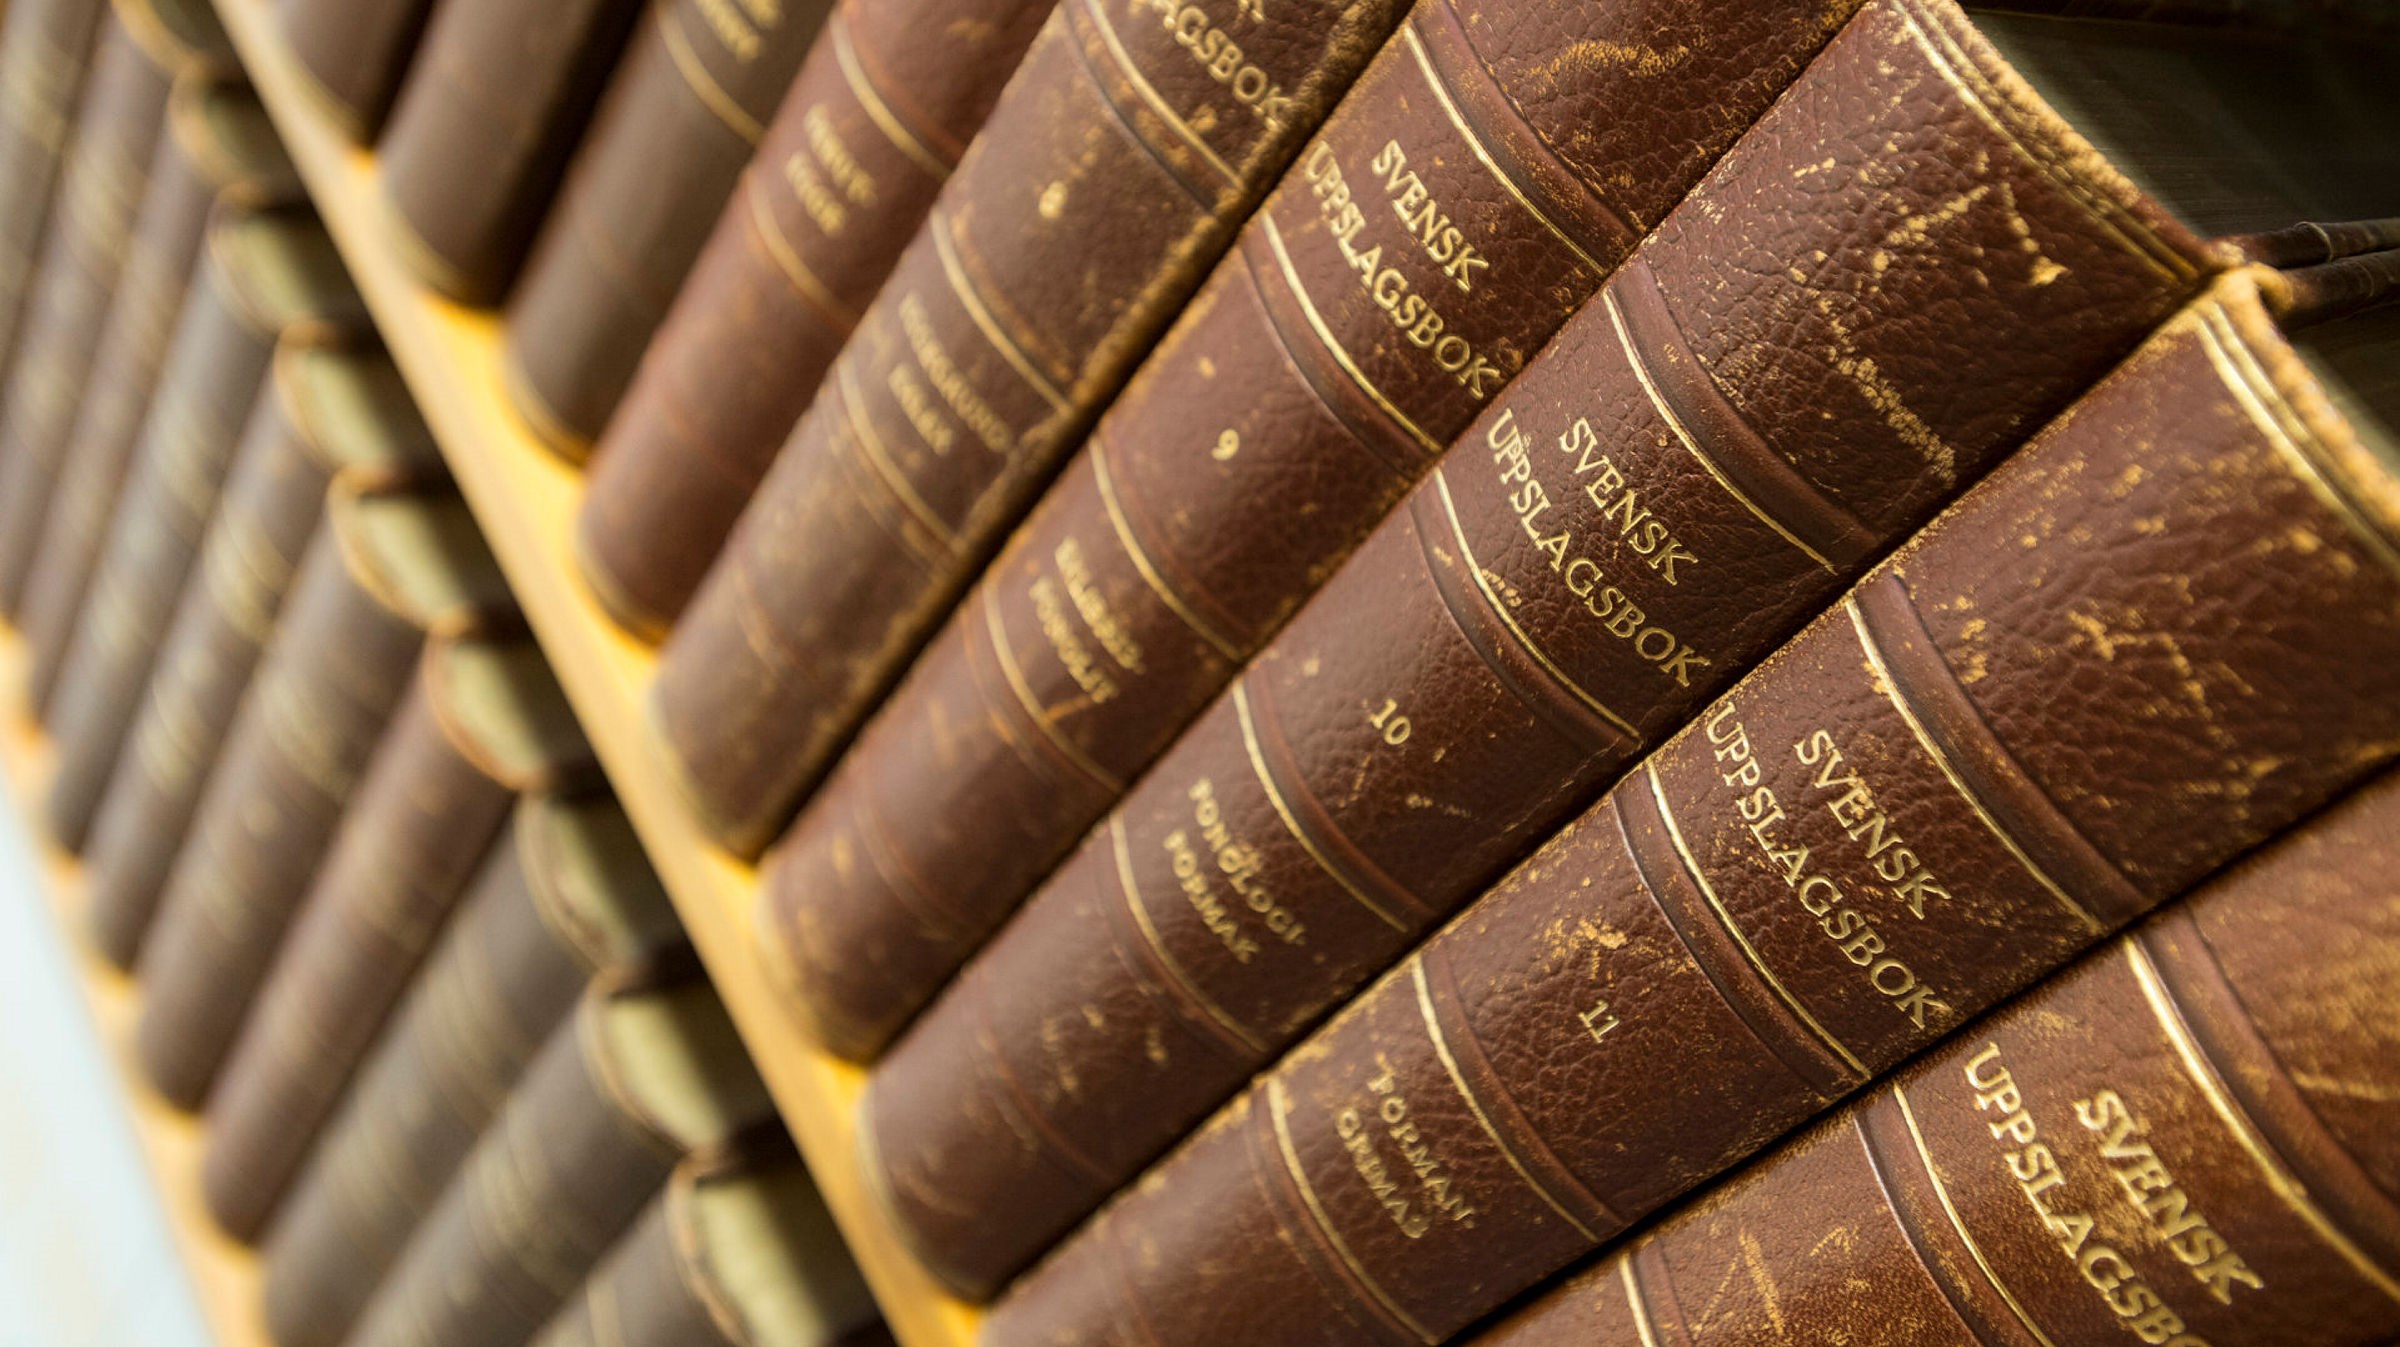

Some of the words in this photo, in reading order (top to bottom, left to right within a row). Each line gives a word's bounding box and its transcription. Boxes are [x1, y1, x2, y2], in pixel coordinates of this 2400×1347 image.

[1305, 141, 1501, 399] UPPSLAGSBOK
[1372, 140, 1489, 292] SVENSK
[1211, 428, 1240, 461] 9
[1559, 417, 1699, 586] SVENSK
[1487, 408, 1711, 687] UPPSLAGSBOK
[1371, 698, 1411, 745] 10
[1706, 702, 1951, 1029] UPPSLAGSBOK
[1794, 730, 1951, 920] SVENSK
[1577, 999, 1620, 1044] 11
[2072, 1090, 2265, 1305] SVENSK
